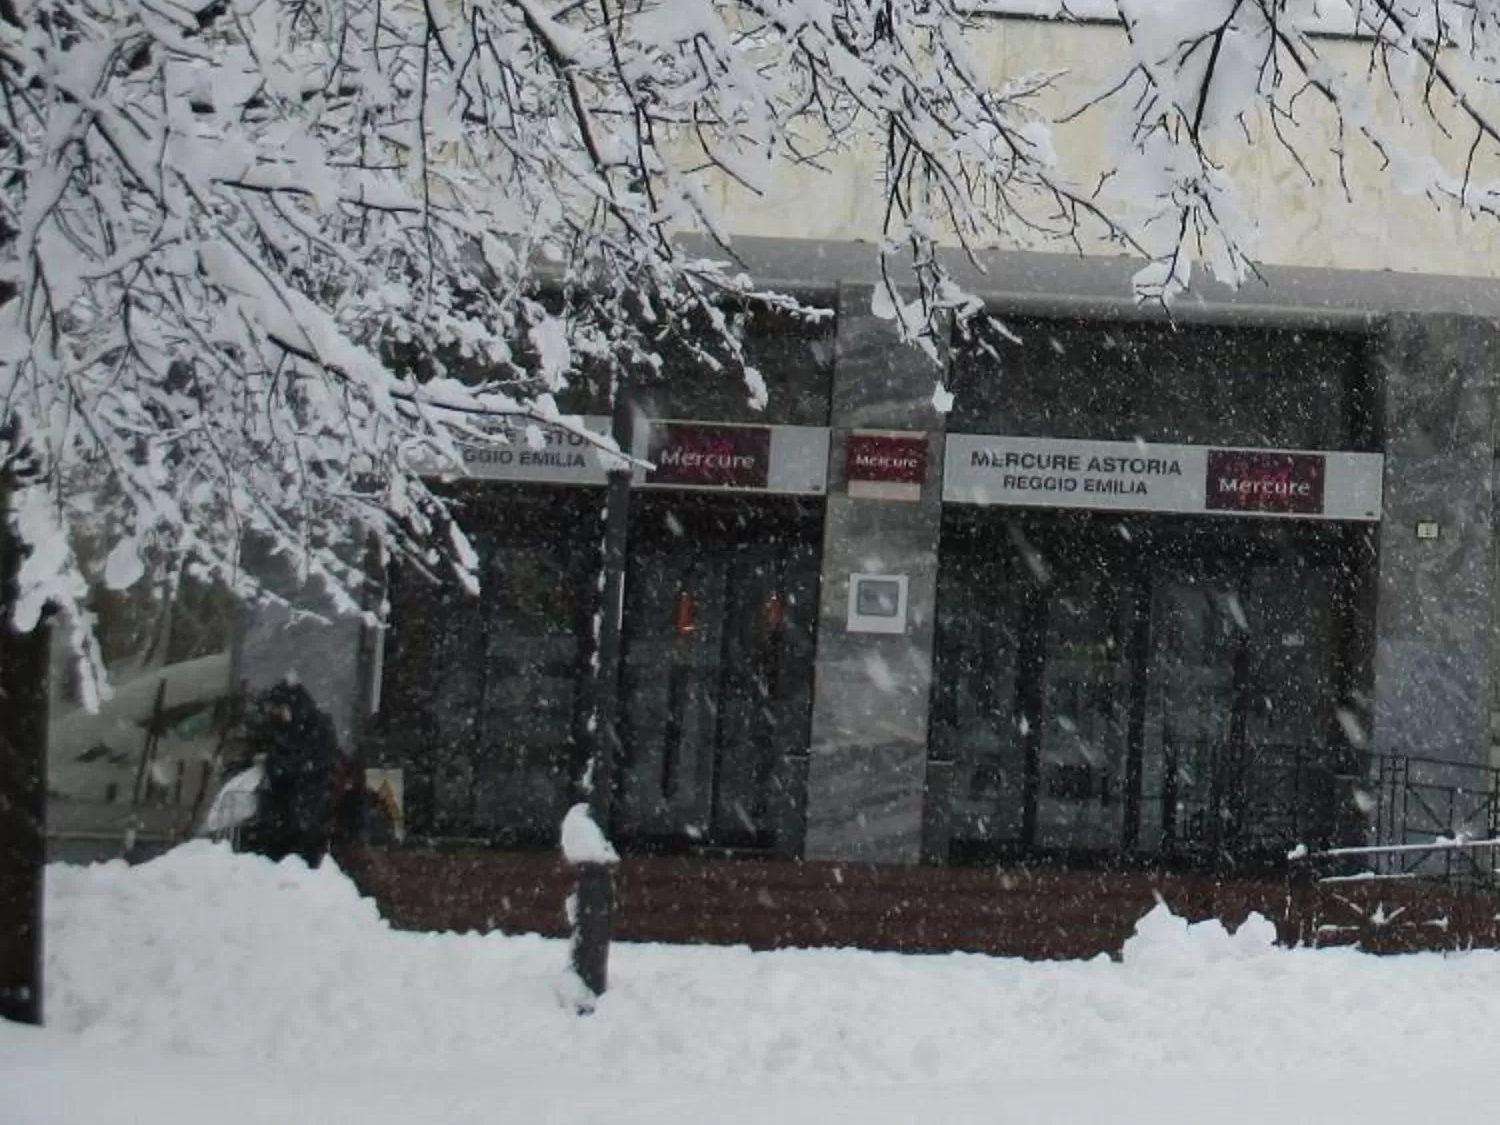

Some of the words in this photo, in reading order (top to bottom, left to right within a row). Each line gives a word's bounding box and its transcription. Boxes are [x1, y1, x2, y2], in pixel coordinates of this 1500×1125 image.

[453, 448, 514, 466] GGIO
[519, 452, 586, 468] EMILIA
[661, 448, 755, 471] Mercure
[855, 454, 918, 469] Mercure
[970, 450, 1081, 471] MERCURE
[1086, 456, 1183, 476] ASTORIA
[1003, 475, 1077, 492] REGGIO
[1083, 478, 1148, 495] EMILIA
[1218, 477, 1310, 496] Mercure
